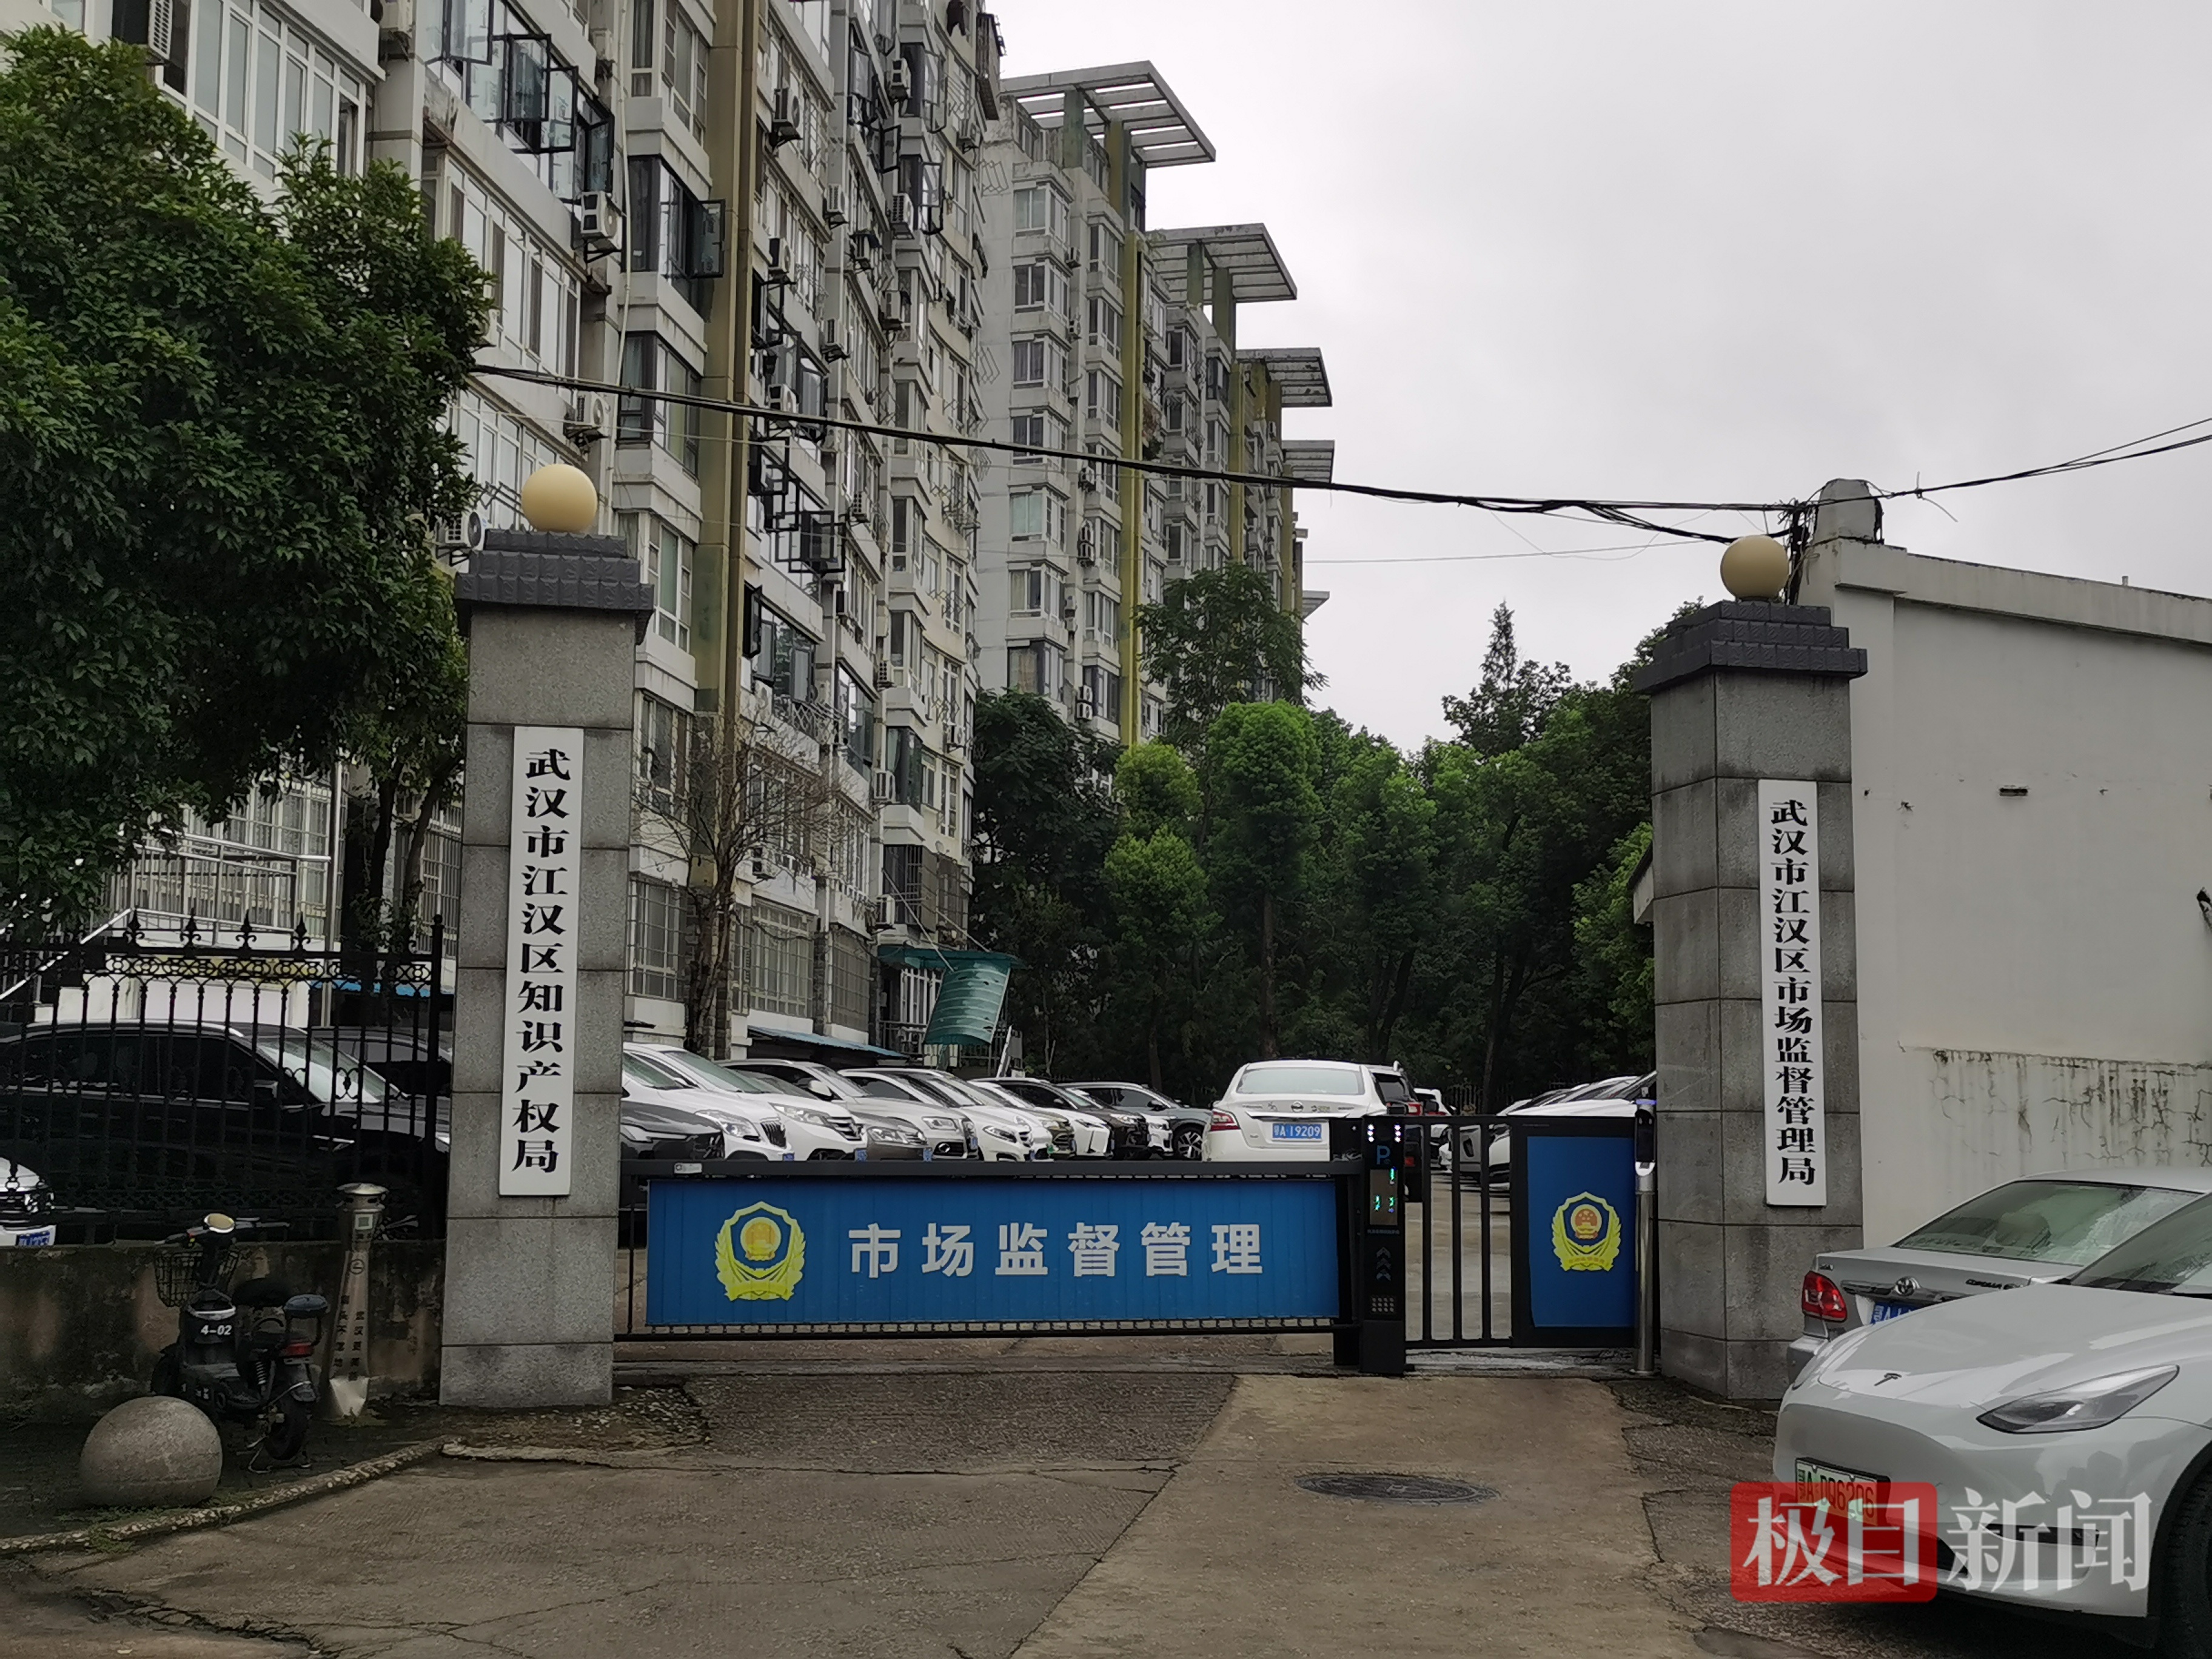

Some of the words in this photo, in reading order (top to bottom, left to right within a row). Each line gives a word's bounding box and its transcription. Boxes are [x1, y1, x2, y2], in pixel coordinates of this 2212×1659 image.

[512, 748, 571, 1173] 武汉市江汉区知识产权局
[1770, 799, 1816, 1186] 武汉市江汉区市场监督管理局
[1376, 1145, 1391, 1165] P
[848, 1222, 1264, 1279] 市场监督管理
[200, 1324, 232, 1335] 4-02
